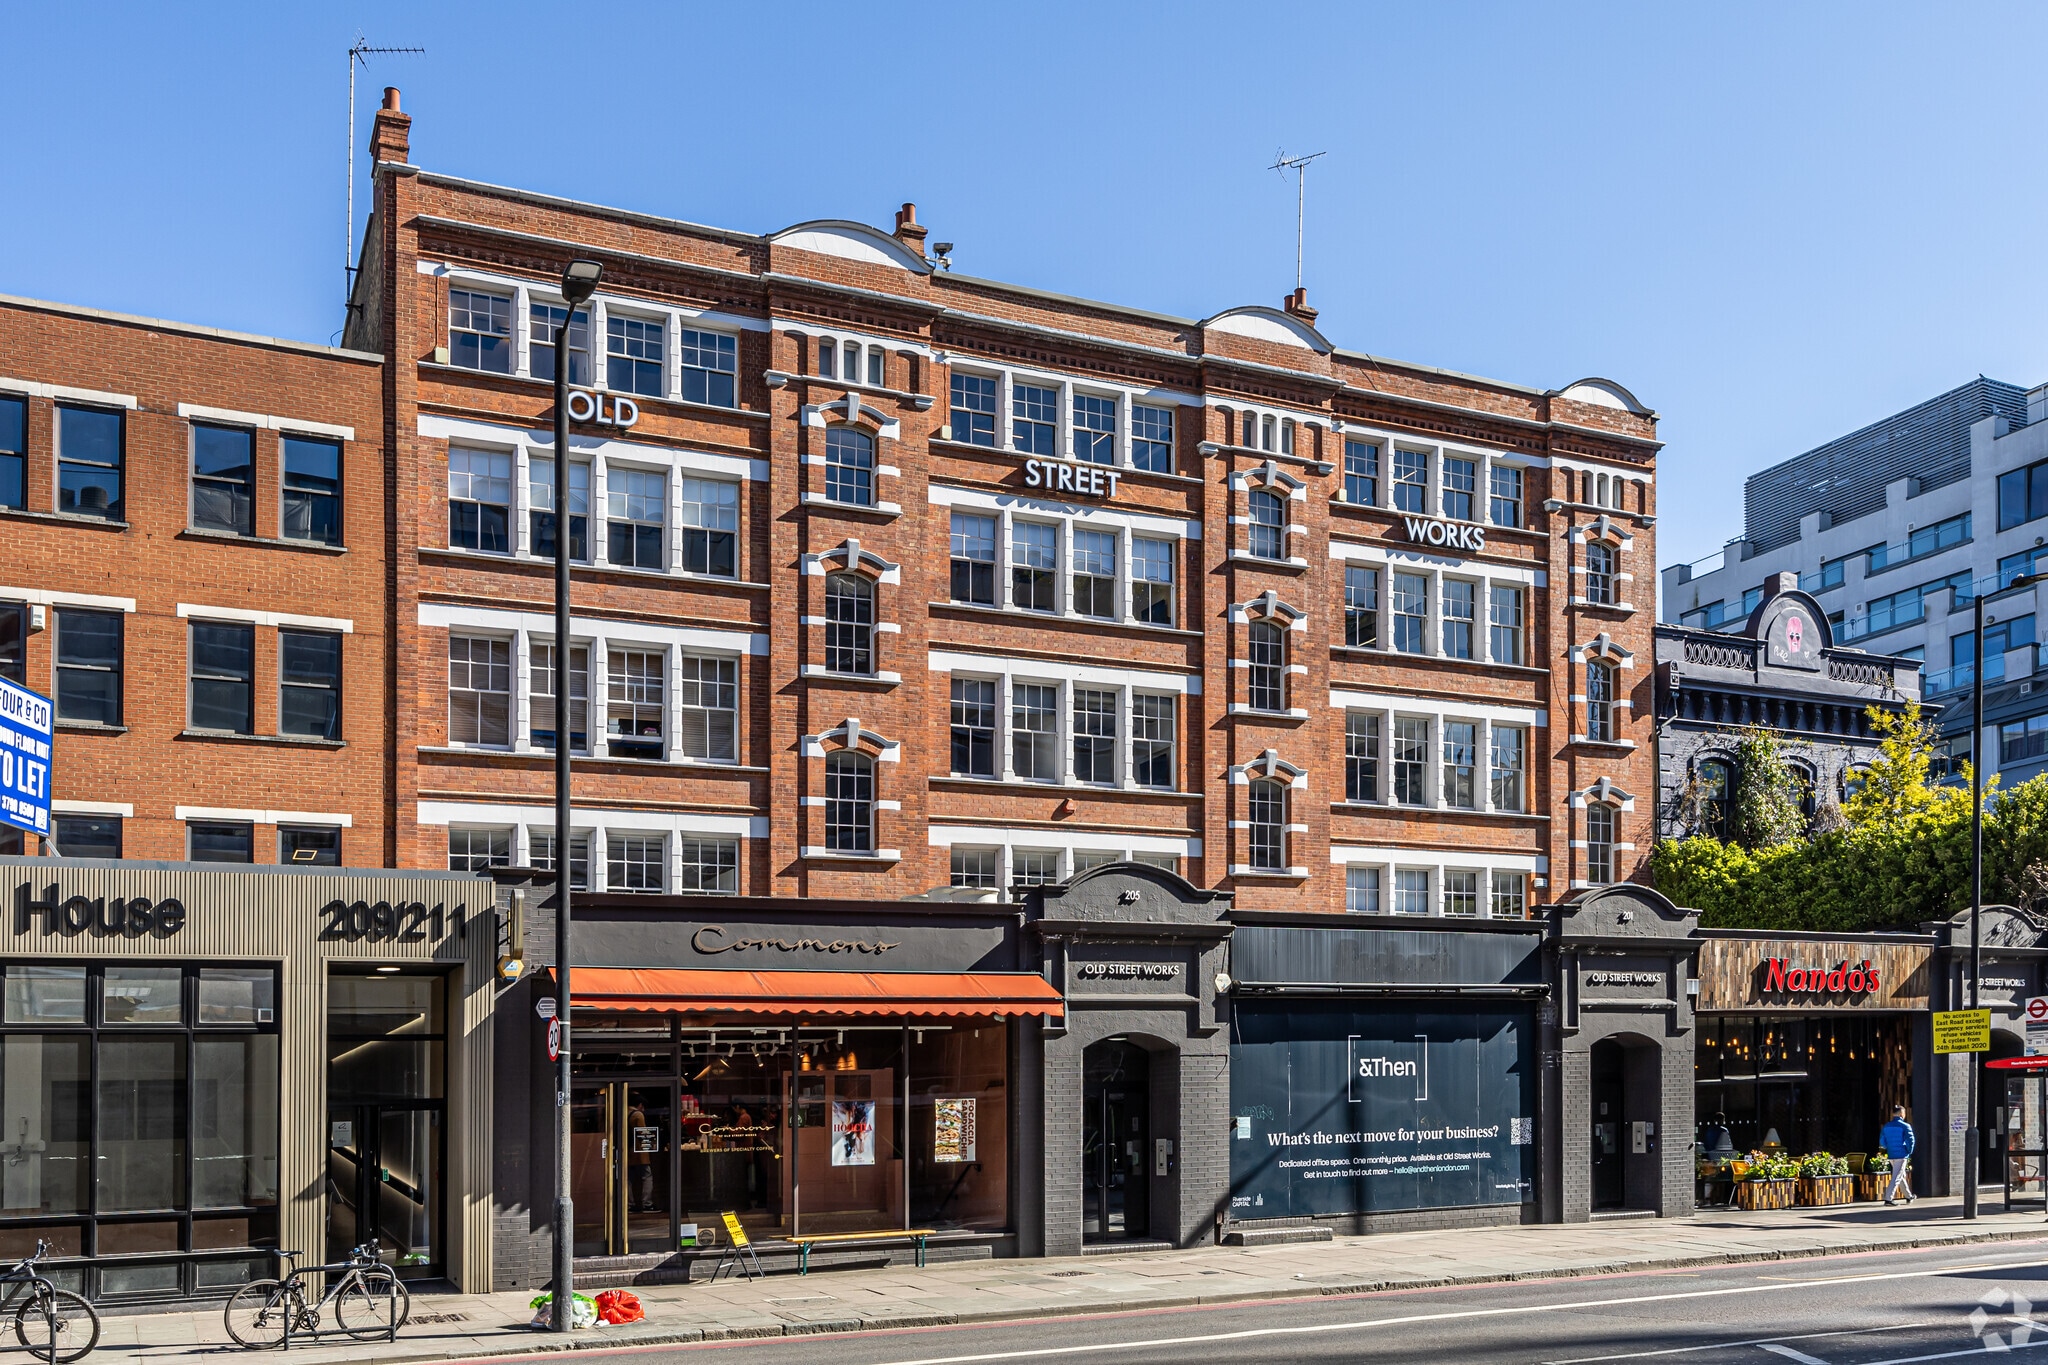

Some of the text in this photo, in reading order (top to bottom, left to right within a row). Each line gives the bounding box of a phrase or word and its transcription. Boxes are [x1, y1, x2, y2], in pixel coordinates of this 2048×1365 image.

[568, 390, 1486, 550] OLD STREET WORKS
[0, 686, 47, 727] OUR & CO
[17, 755, 47, 799] LET
[1125, 889, 1140, 900] 205
[20, 882, 186, 936] House
[1623, 911, 1633, 920] 201
[321, 899, 466, 941] 209/211
[694, 925, 902, 953] Commons
[1085, 963, 1180, 975] OLD STREET WORKS
[1592, 972, 1661, 982] OLD STREET WORKS
[1763, 957, 1880, 993] Nando's
[1985, 978, 2004, 986] STREET
[2004, 978, 2026, 987] WORKS
[549, 1029, 558, 1048] 20
[1359, 1056, 1416, 1077] &Then
[699, 1123, 775, 1134] Commons
[1267, 1125, 1499, 1146] What's the next move for your business?
[1279, 1159, 1311, 1168] Dedicated
[1312, 1158, 1330, 1166] office
[1330, 1158, 1351, 1167] space.
[1367, 1156, 1391, 1165] monthly
[1392, 1155, 1408, 1164] price.
[1410, 1153, 1436, 1162] Available
[1443, 1152, 1454, 1160] Old
[1454, 1152, 1471, 1160] Street
[1472, 1151, 1491, 1159] Works.
[1304, 1171, 1315, 1179] Get
[1316, 1170, 1322, 1178] in
[1323, 1170, 1341, 1178] touch
